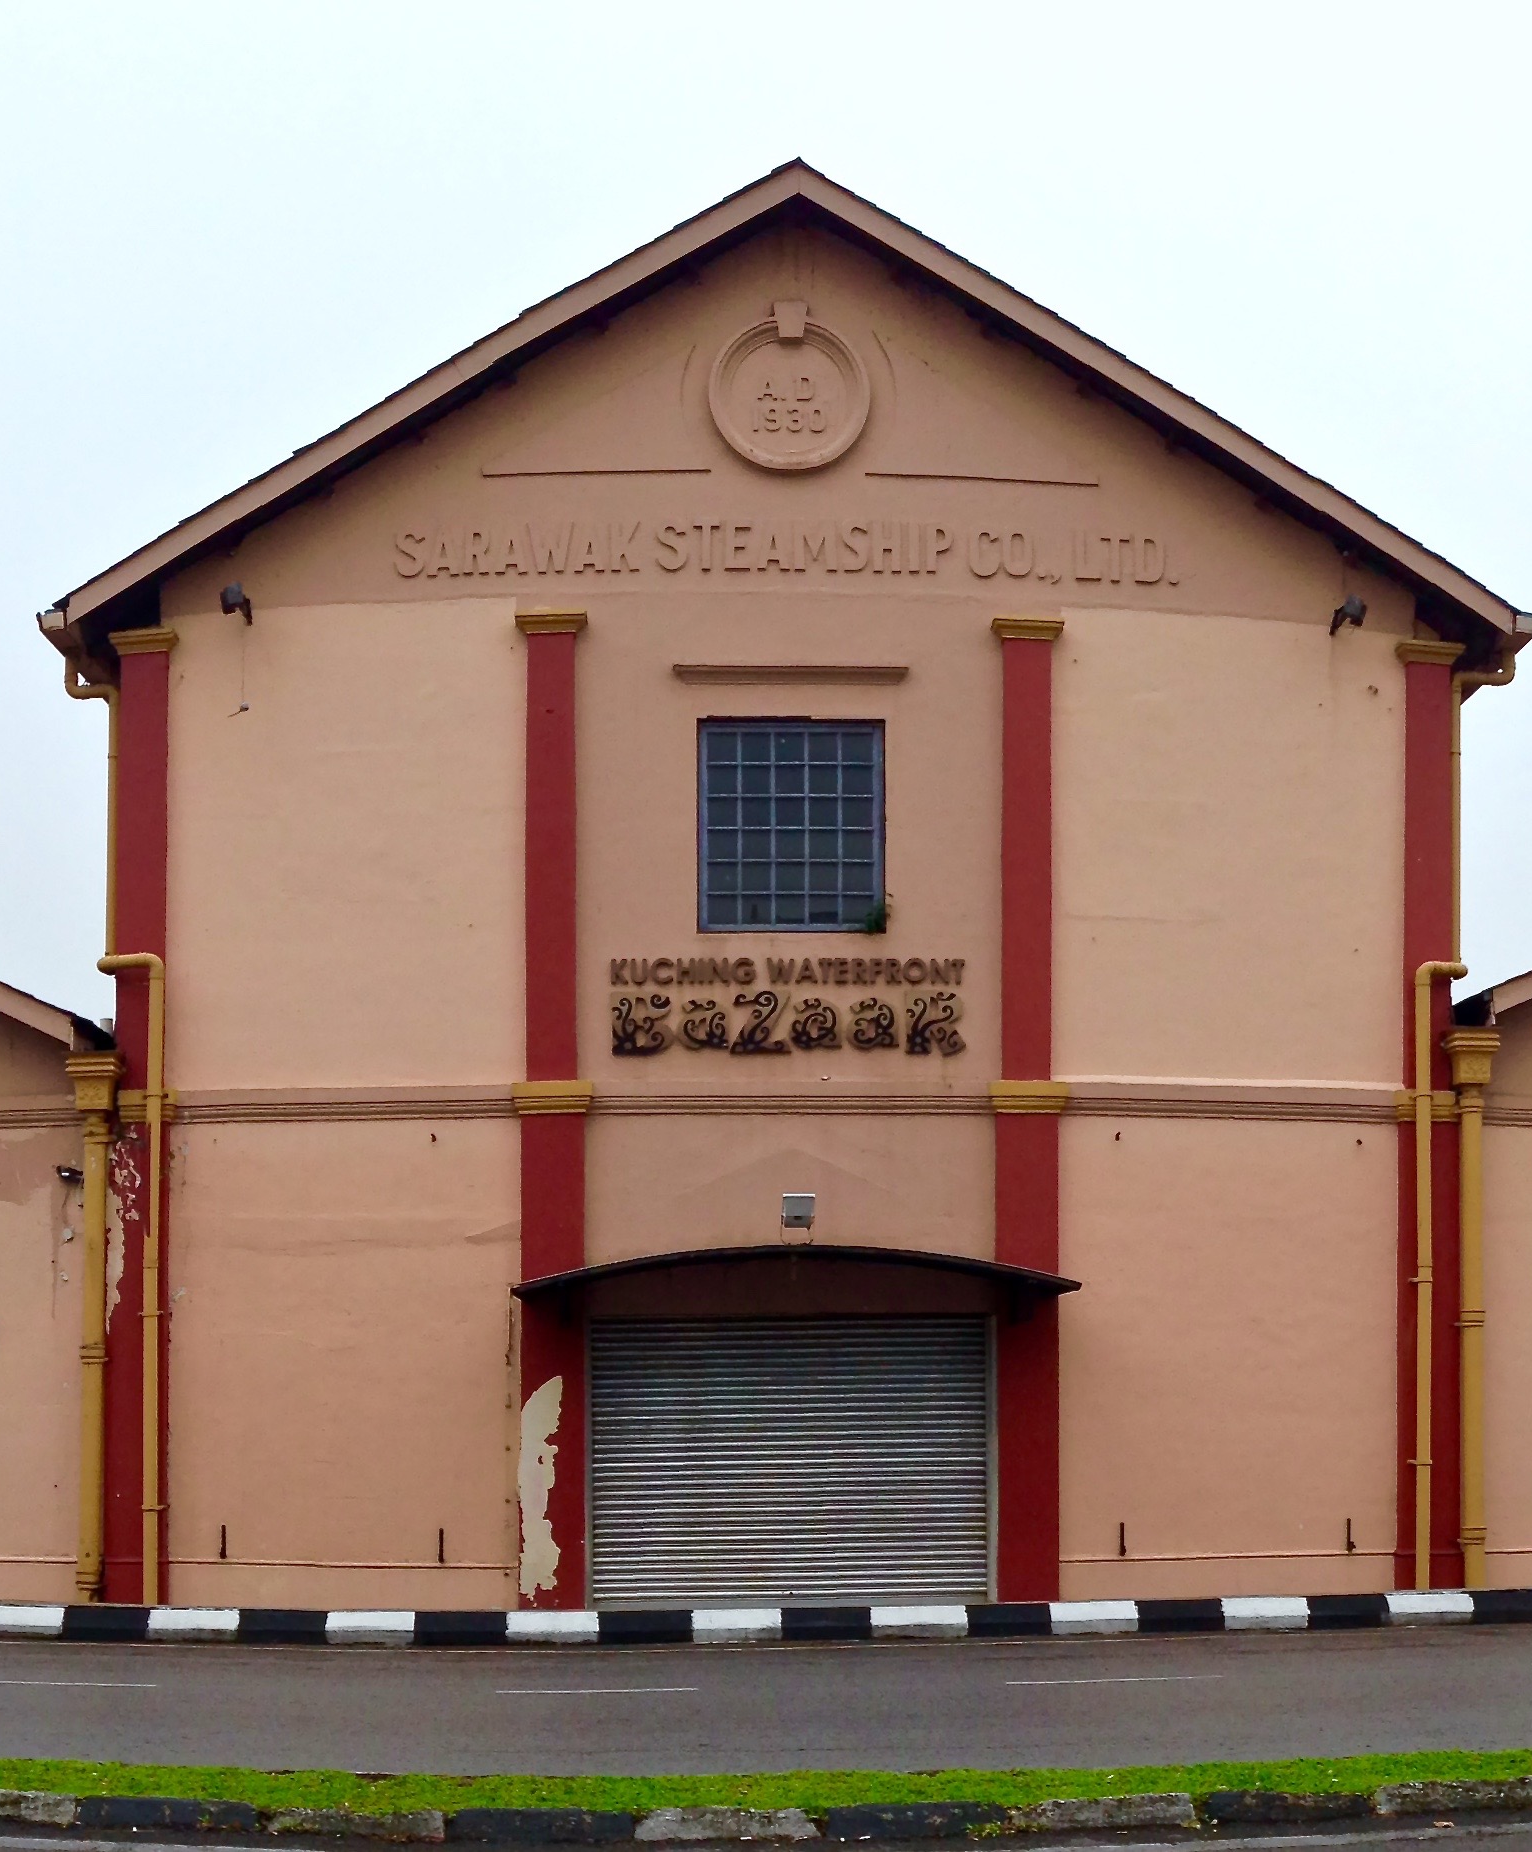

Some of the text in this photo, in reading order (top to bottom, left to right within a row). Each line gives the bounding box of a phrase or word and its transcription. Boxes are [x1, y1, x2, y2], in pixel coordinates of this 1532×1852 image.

[752, 405, 827, 434] 1930
[392, 522, 641, 578] SARAWAK
[655, 520, 955, 575] STEAMSHIP
[1072, 527, 1180, 587] LTD.
[610, 957, 967, 987] KUCHING WATERFRONT
